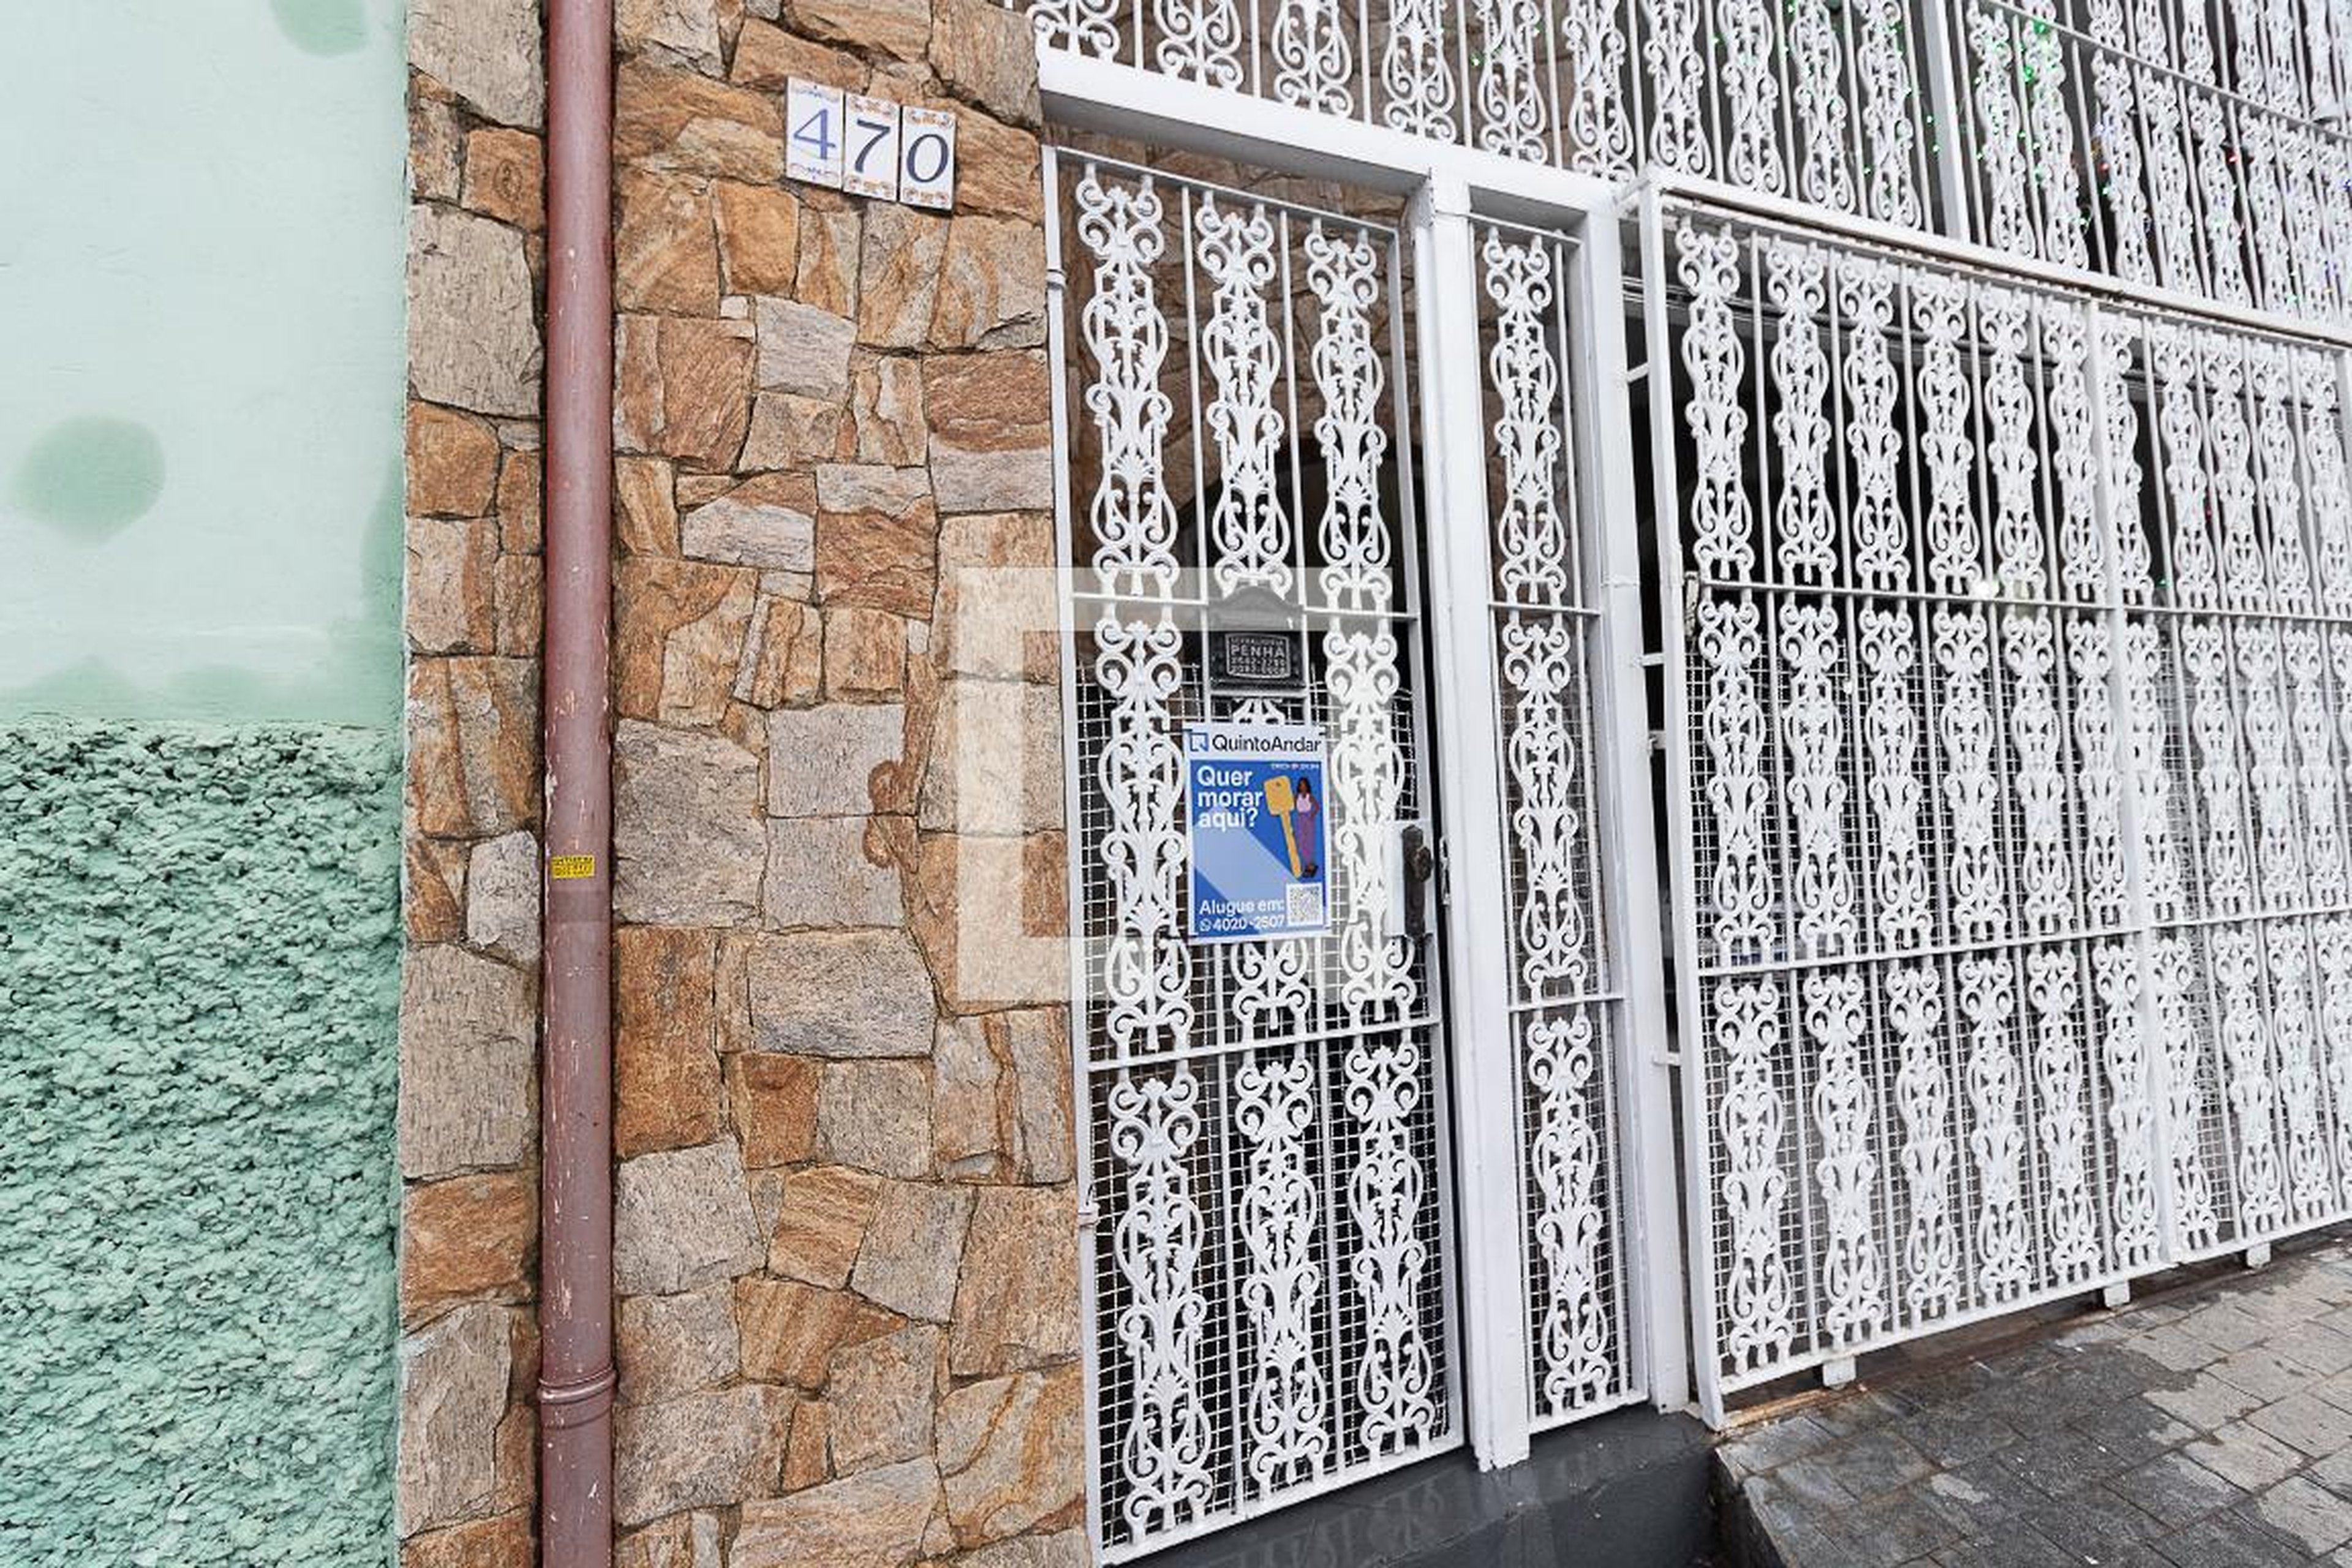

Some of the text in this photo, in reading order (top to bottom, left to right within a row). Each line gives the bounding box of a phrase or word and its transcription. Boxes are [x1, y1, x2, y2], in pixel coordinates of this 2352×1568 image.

[793, 108, 949, 183] 470
[1231, 644, 1285, 658] PENHA
[1212, 734, 1322, 752] QuintoAndar
[1197, 766, 1253, 786] Quer
[1197, 791, 1263, 807] morar
[1199, 807, 1259, 832] aqui?
[1199, 899, 1285, 918] Alugue em:
